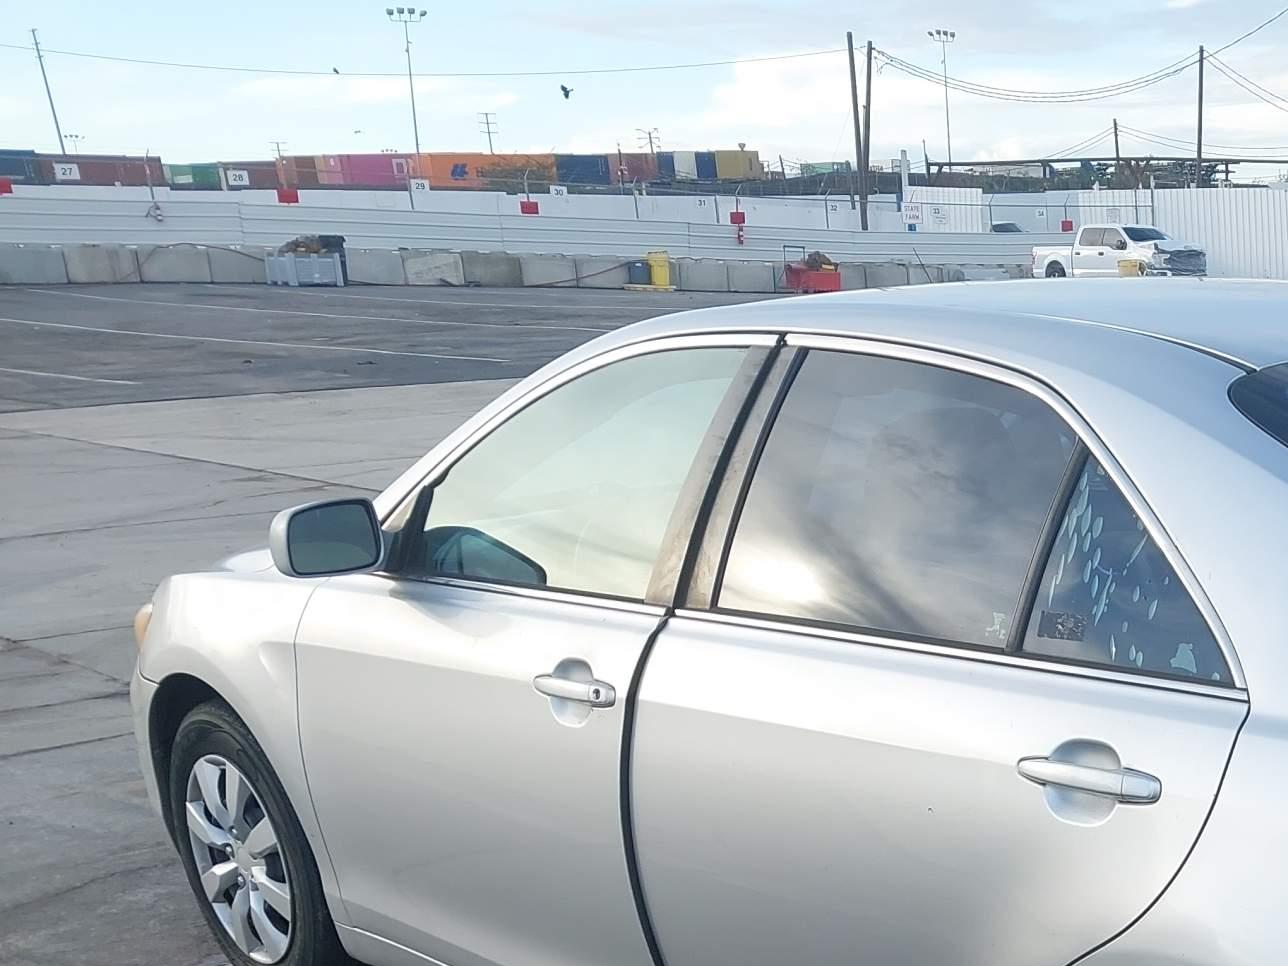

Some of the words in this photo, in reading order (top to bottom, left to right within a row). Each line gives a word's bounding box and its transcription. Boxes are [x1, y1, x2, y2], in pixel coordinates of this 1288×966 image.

[61, 167, 73, 176] 27
[232, 173, 244, 181] 28
[415, 182, 426, 190] 29
[554, 188, 564, 196] 30
